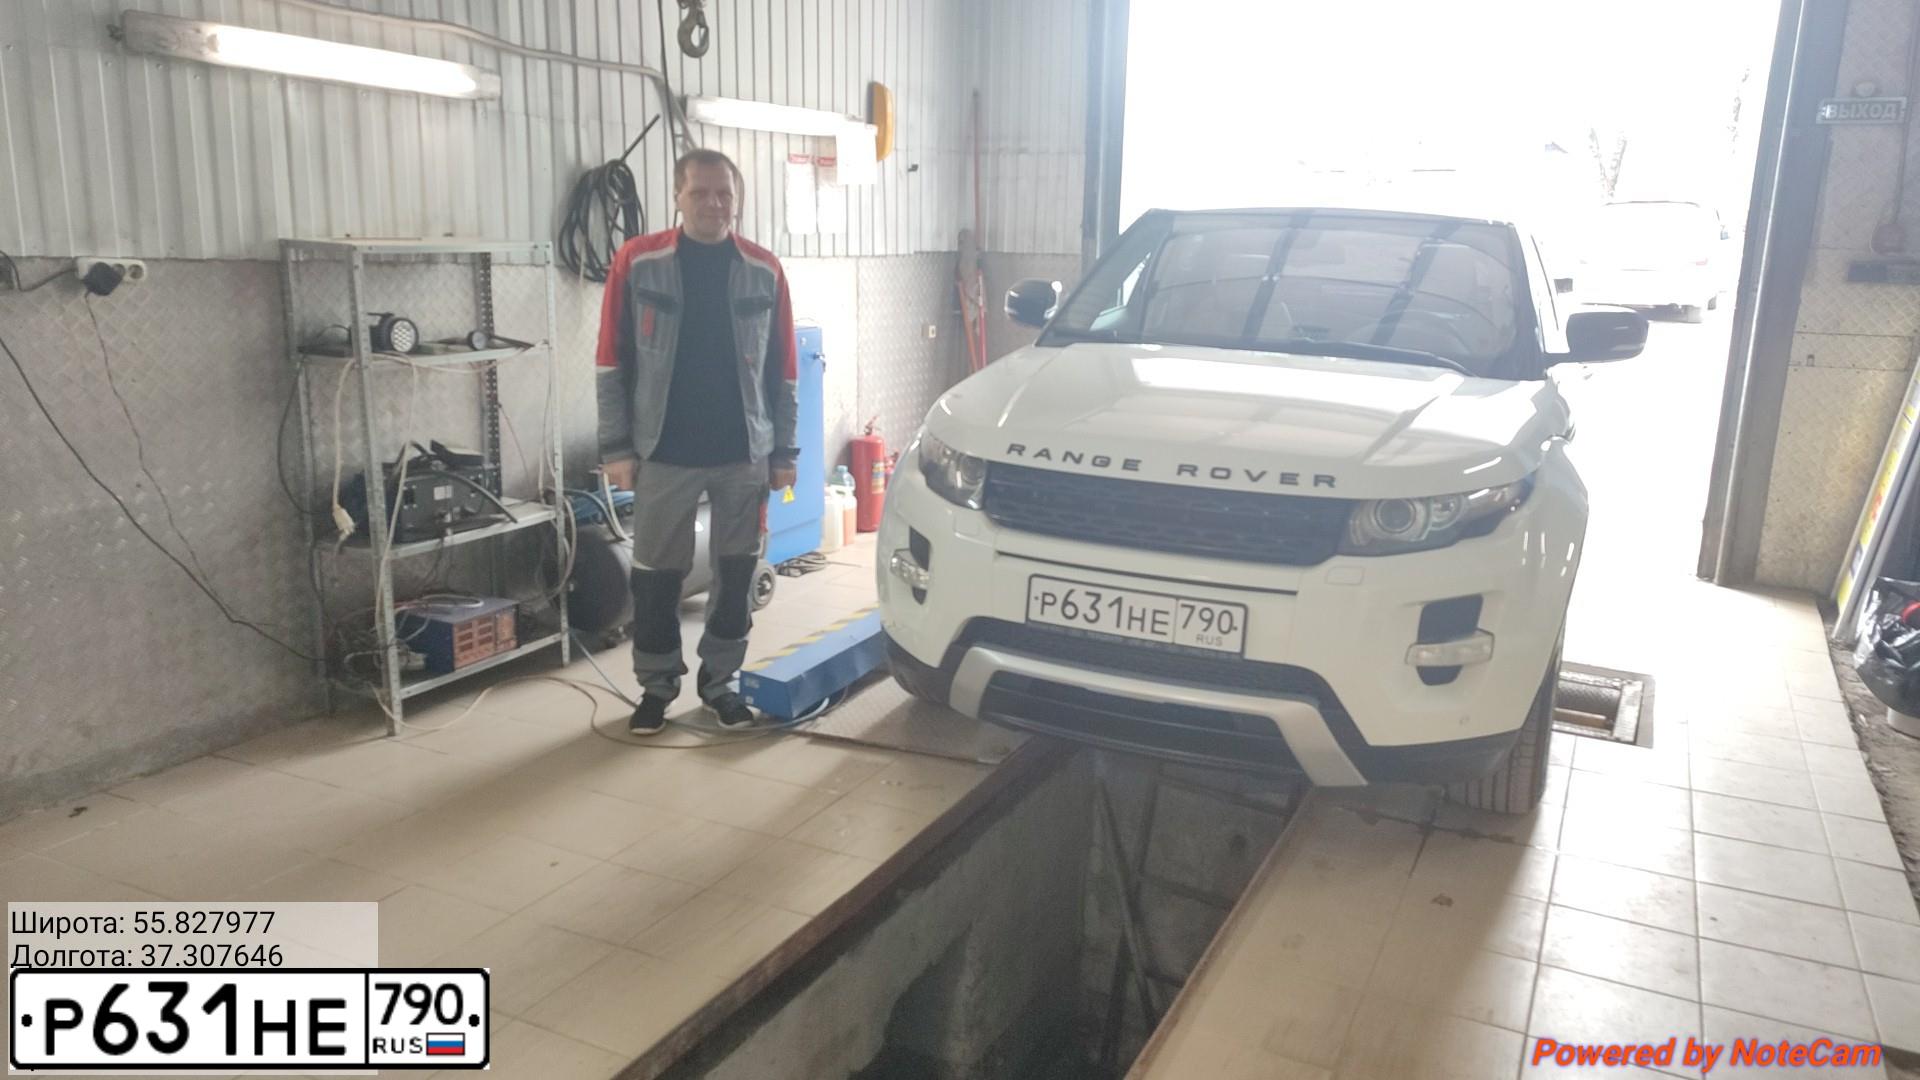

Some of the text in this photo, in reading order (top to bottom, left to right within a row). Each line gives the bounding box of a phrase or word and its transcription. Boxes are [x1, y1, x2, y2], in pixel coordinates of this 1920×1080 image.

[1825, 103, 1897, 119] ВЫХОД
[1006, 443, 1336, 489] RANGE ROVER
[1180, 603, 1234, 635] 790
[1196, 633, 1223, 646] RUS
